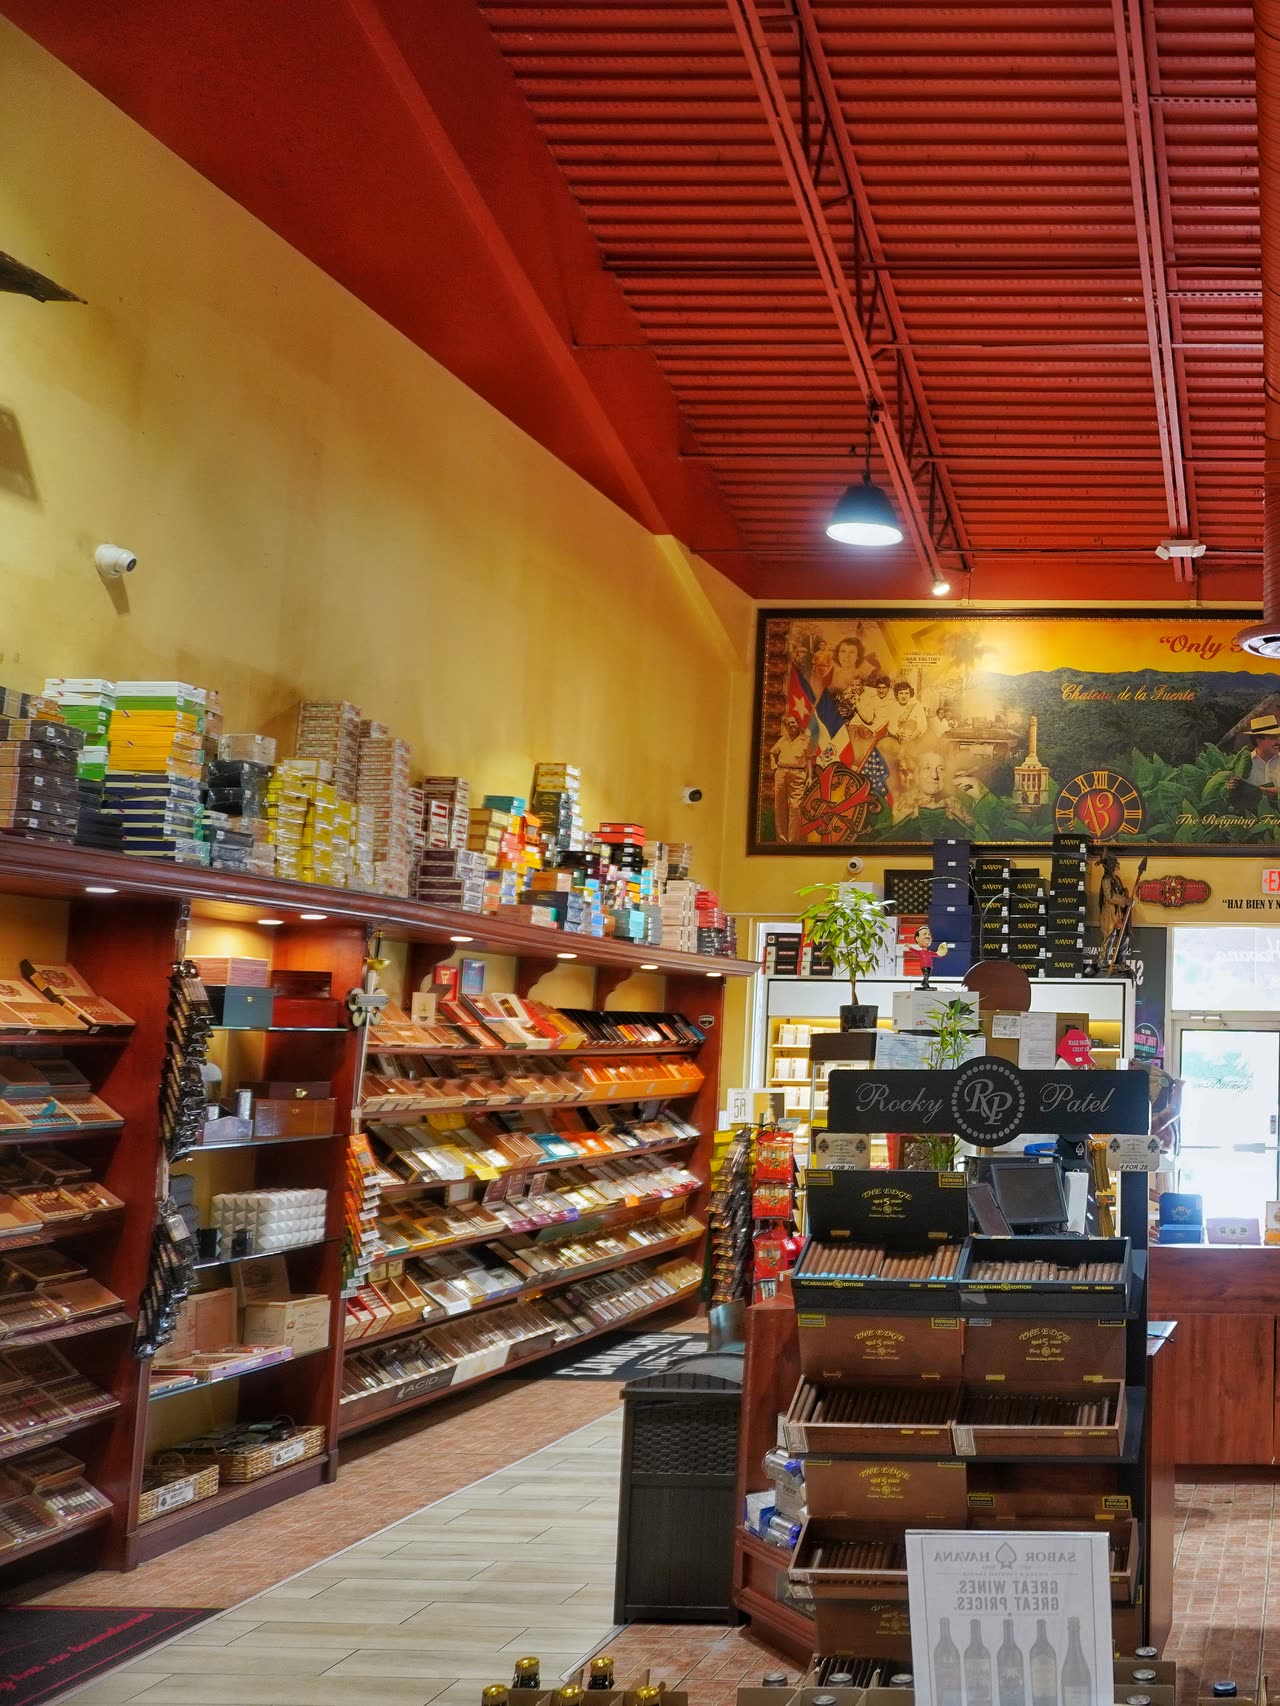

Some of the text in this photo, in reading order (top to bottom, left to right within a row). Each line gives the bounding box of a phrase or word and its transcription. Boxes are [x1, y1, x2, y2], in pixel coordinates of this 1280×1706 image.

[1061, 682, 1197, 702] Chateau de la Fuente
[1175, 813, 1199, 826] The
[1201, 813, 1256, 829] Reigning
[1246, 899, 1266, 910] BIEN
[1268, 900, 1274, 910] Y
[855, 1082, 945, 1123] Rocky
[1039, 1082, 1117, 1113] Patel
[861, 1188, 913, 1201] THE EDGE
[854, 1329, 906, 1342] THE EDGE
[1018, 1328, 1071, 1342] THE EDGE
[859, 1467, 911, 1480] THE EDGE
